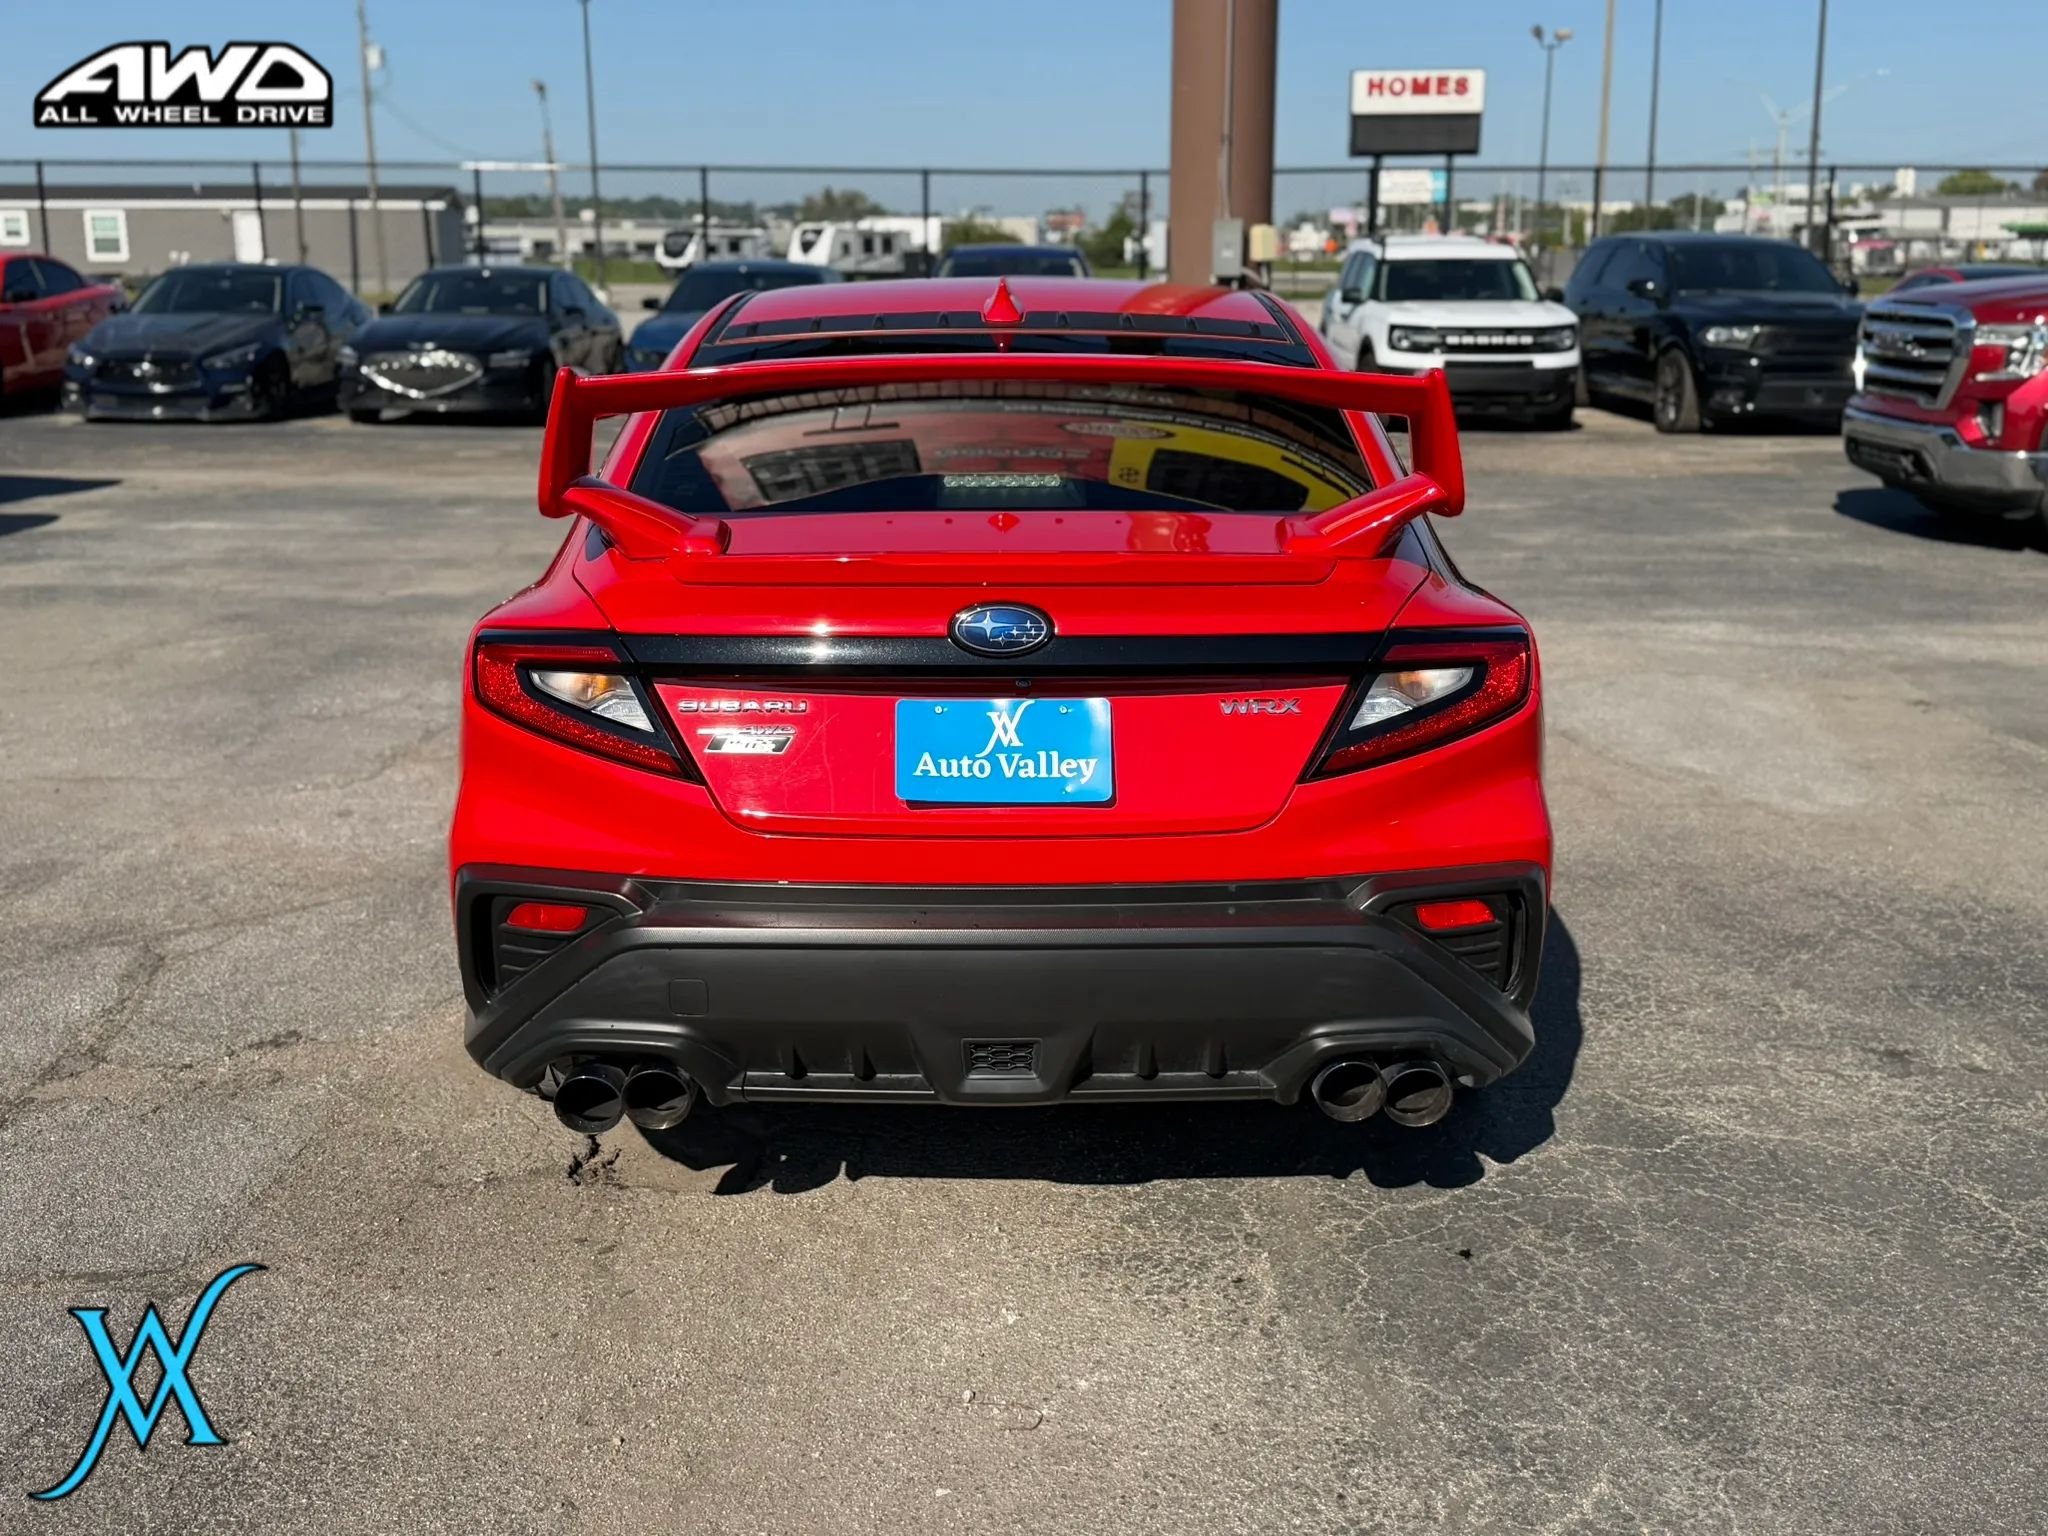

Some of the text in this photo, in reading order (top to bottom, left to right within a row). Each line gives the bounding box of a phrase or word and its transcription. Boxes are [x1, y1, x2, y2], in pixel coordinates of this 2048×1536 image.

[1367, 76, 1470, 97] HOMES
[678, 700, 807, 713] SUBARU
[1220, 699, 1302, 715] WRX
[912, 750, 1099, 785] Auto Valley
